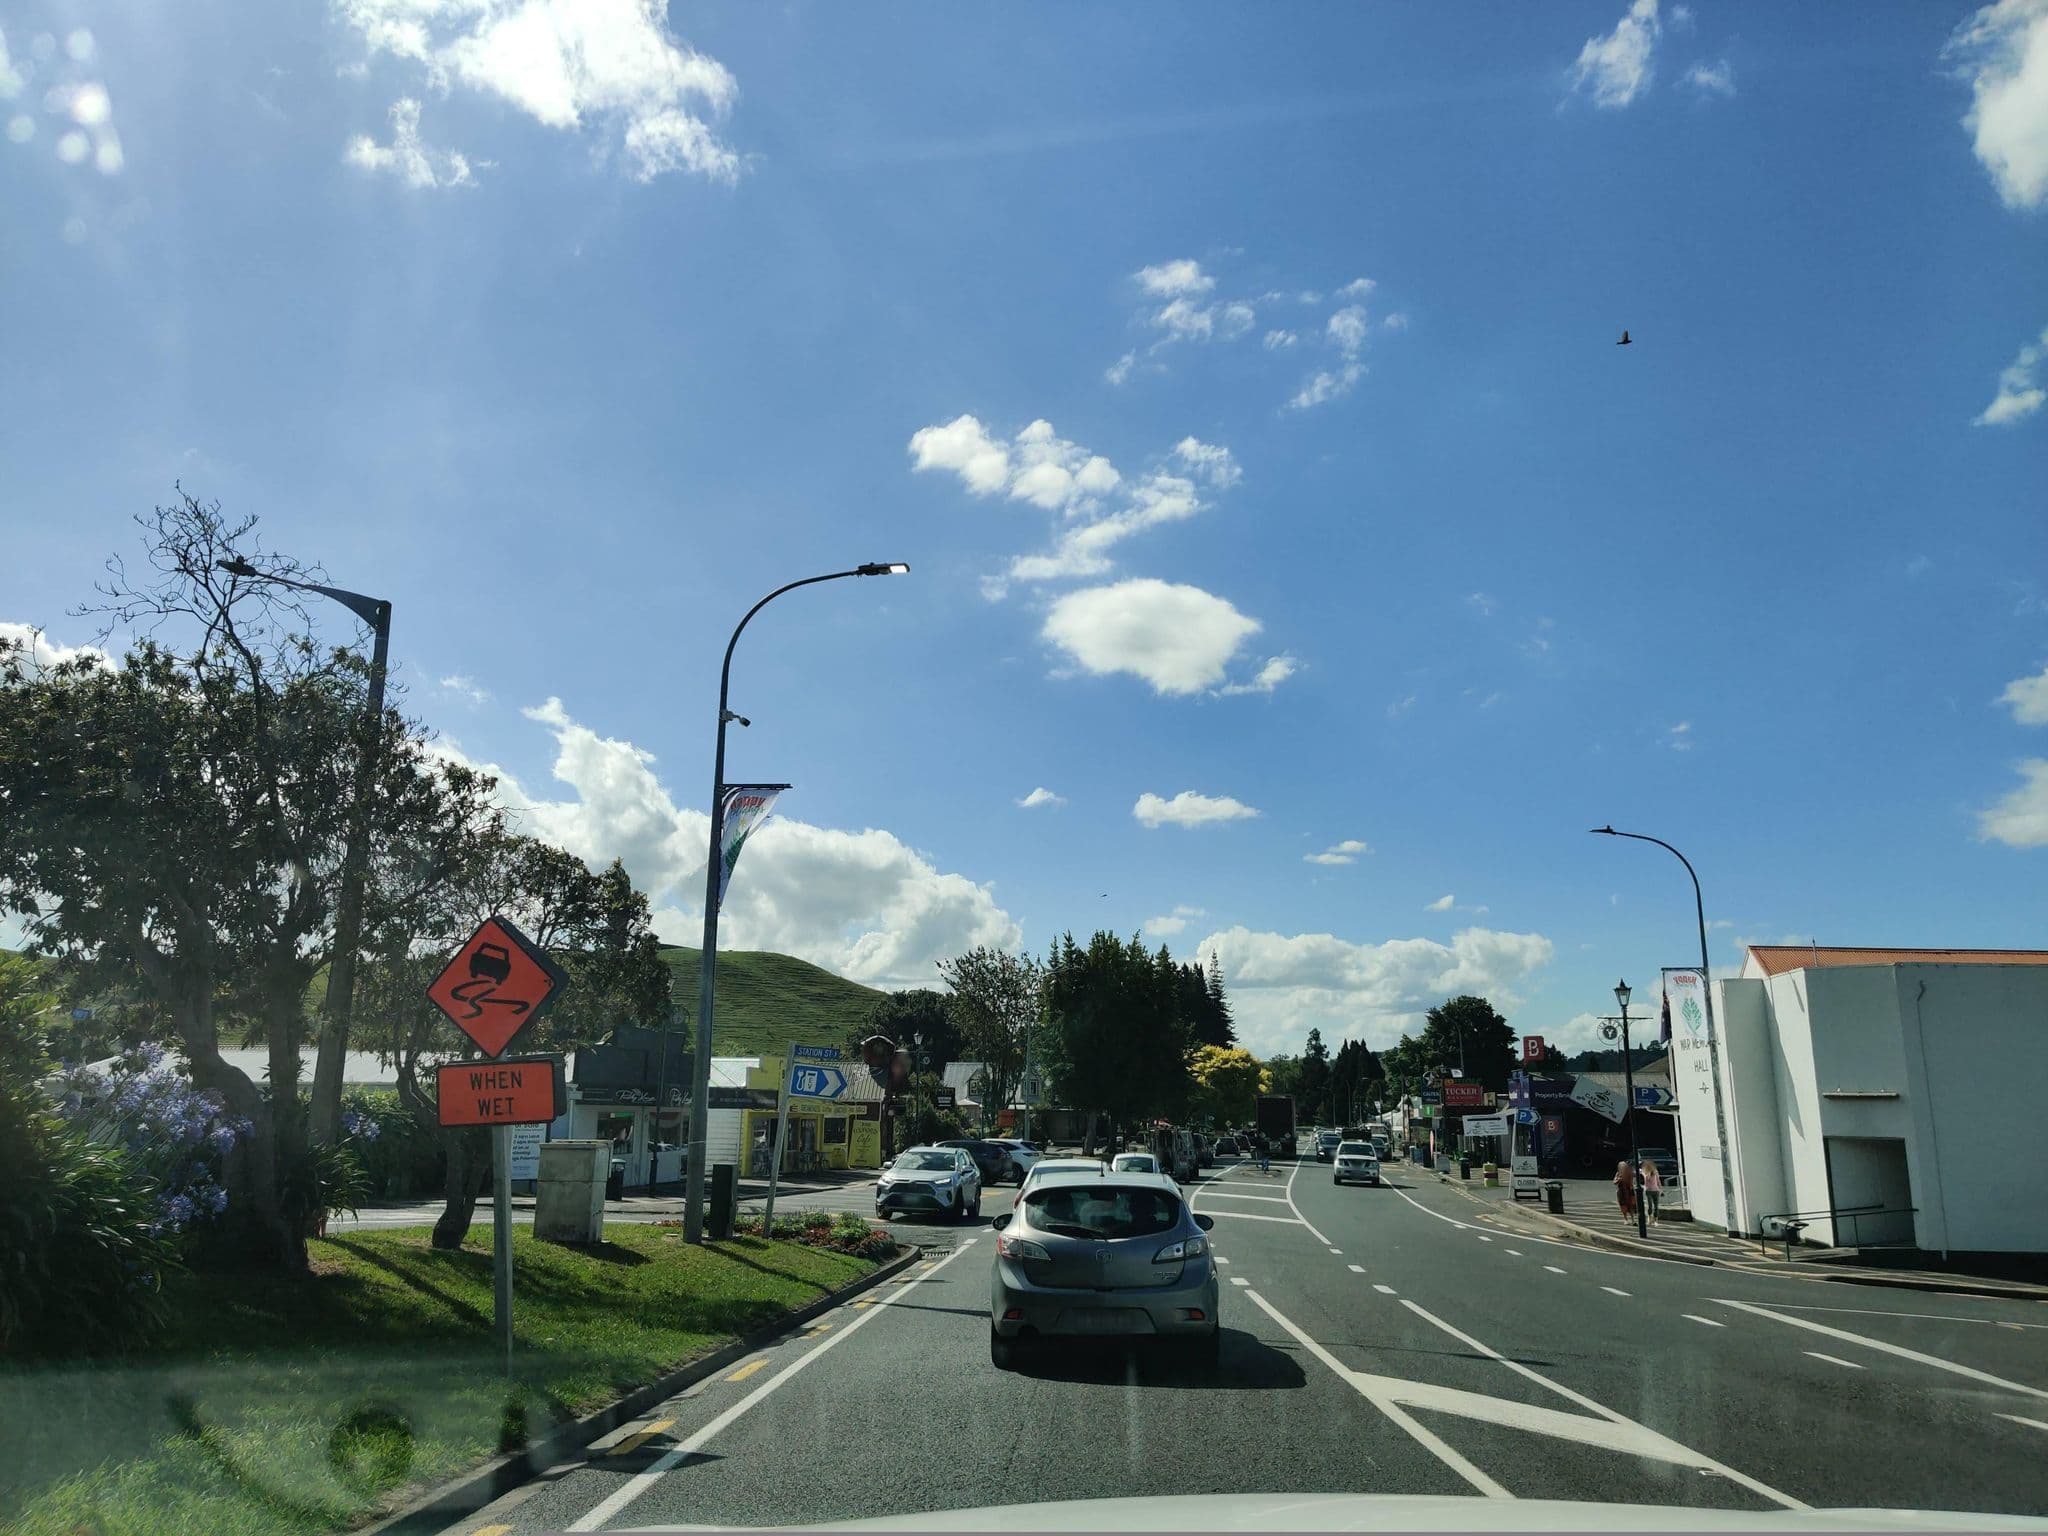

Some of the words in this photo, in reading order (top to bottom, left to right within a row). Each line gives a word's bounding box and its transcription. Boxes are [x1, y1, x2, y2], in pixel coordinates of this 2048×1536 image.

[798, 1047, 822, 1057] STATION
[1528, 1039, 1539, 1057] B
[1694, 1059, 1709, 1072] HALL
[470, 1070, 522, 1090] WHEN
[1641, 1088, 1649, 1097] P
[478, 1097, 514, 1117] WET
[1519, 1111, 1527, 1121] P
